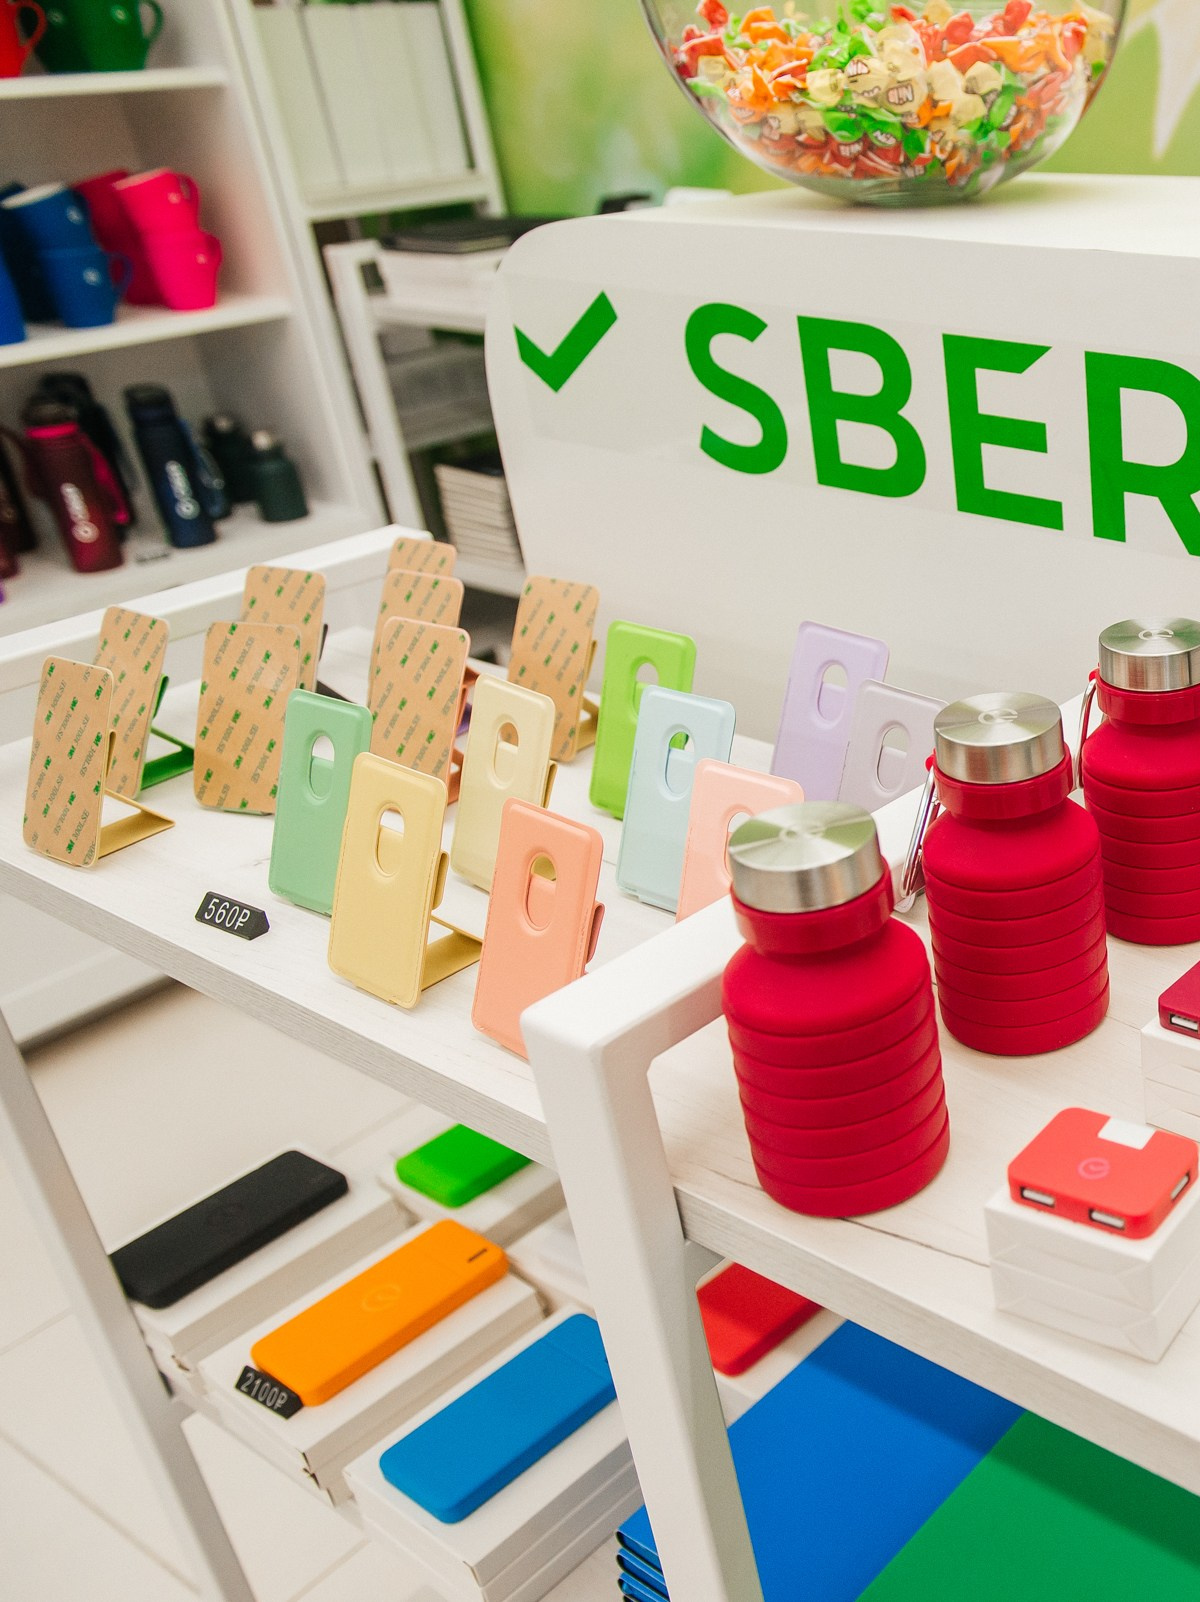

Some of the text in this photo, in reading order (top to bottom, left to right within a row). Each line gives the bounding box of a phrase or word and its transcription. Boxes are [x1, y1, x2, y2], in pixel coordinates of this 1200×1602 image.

[47, 662, 55, 677] 3M
[94, 685, 103, 700] 3M
[70, 697, 78, 711] 3M
[44, 710, 53, 725] 3M
[93, 731, 102, 747] 3M
[67, 745, 76, 760] 3M
[43, 755, 51, 770] 3M
[67, 791, 76, 806] 3M
[42, 803, 50, 818] 3M
[66, 839, 75, 854] 3M
